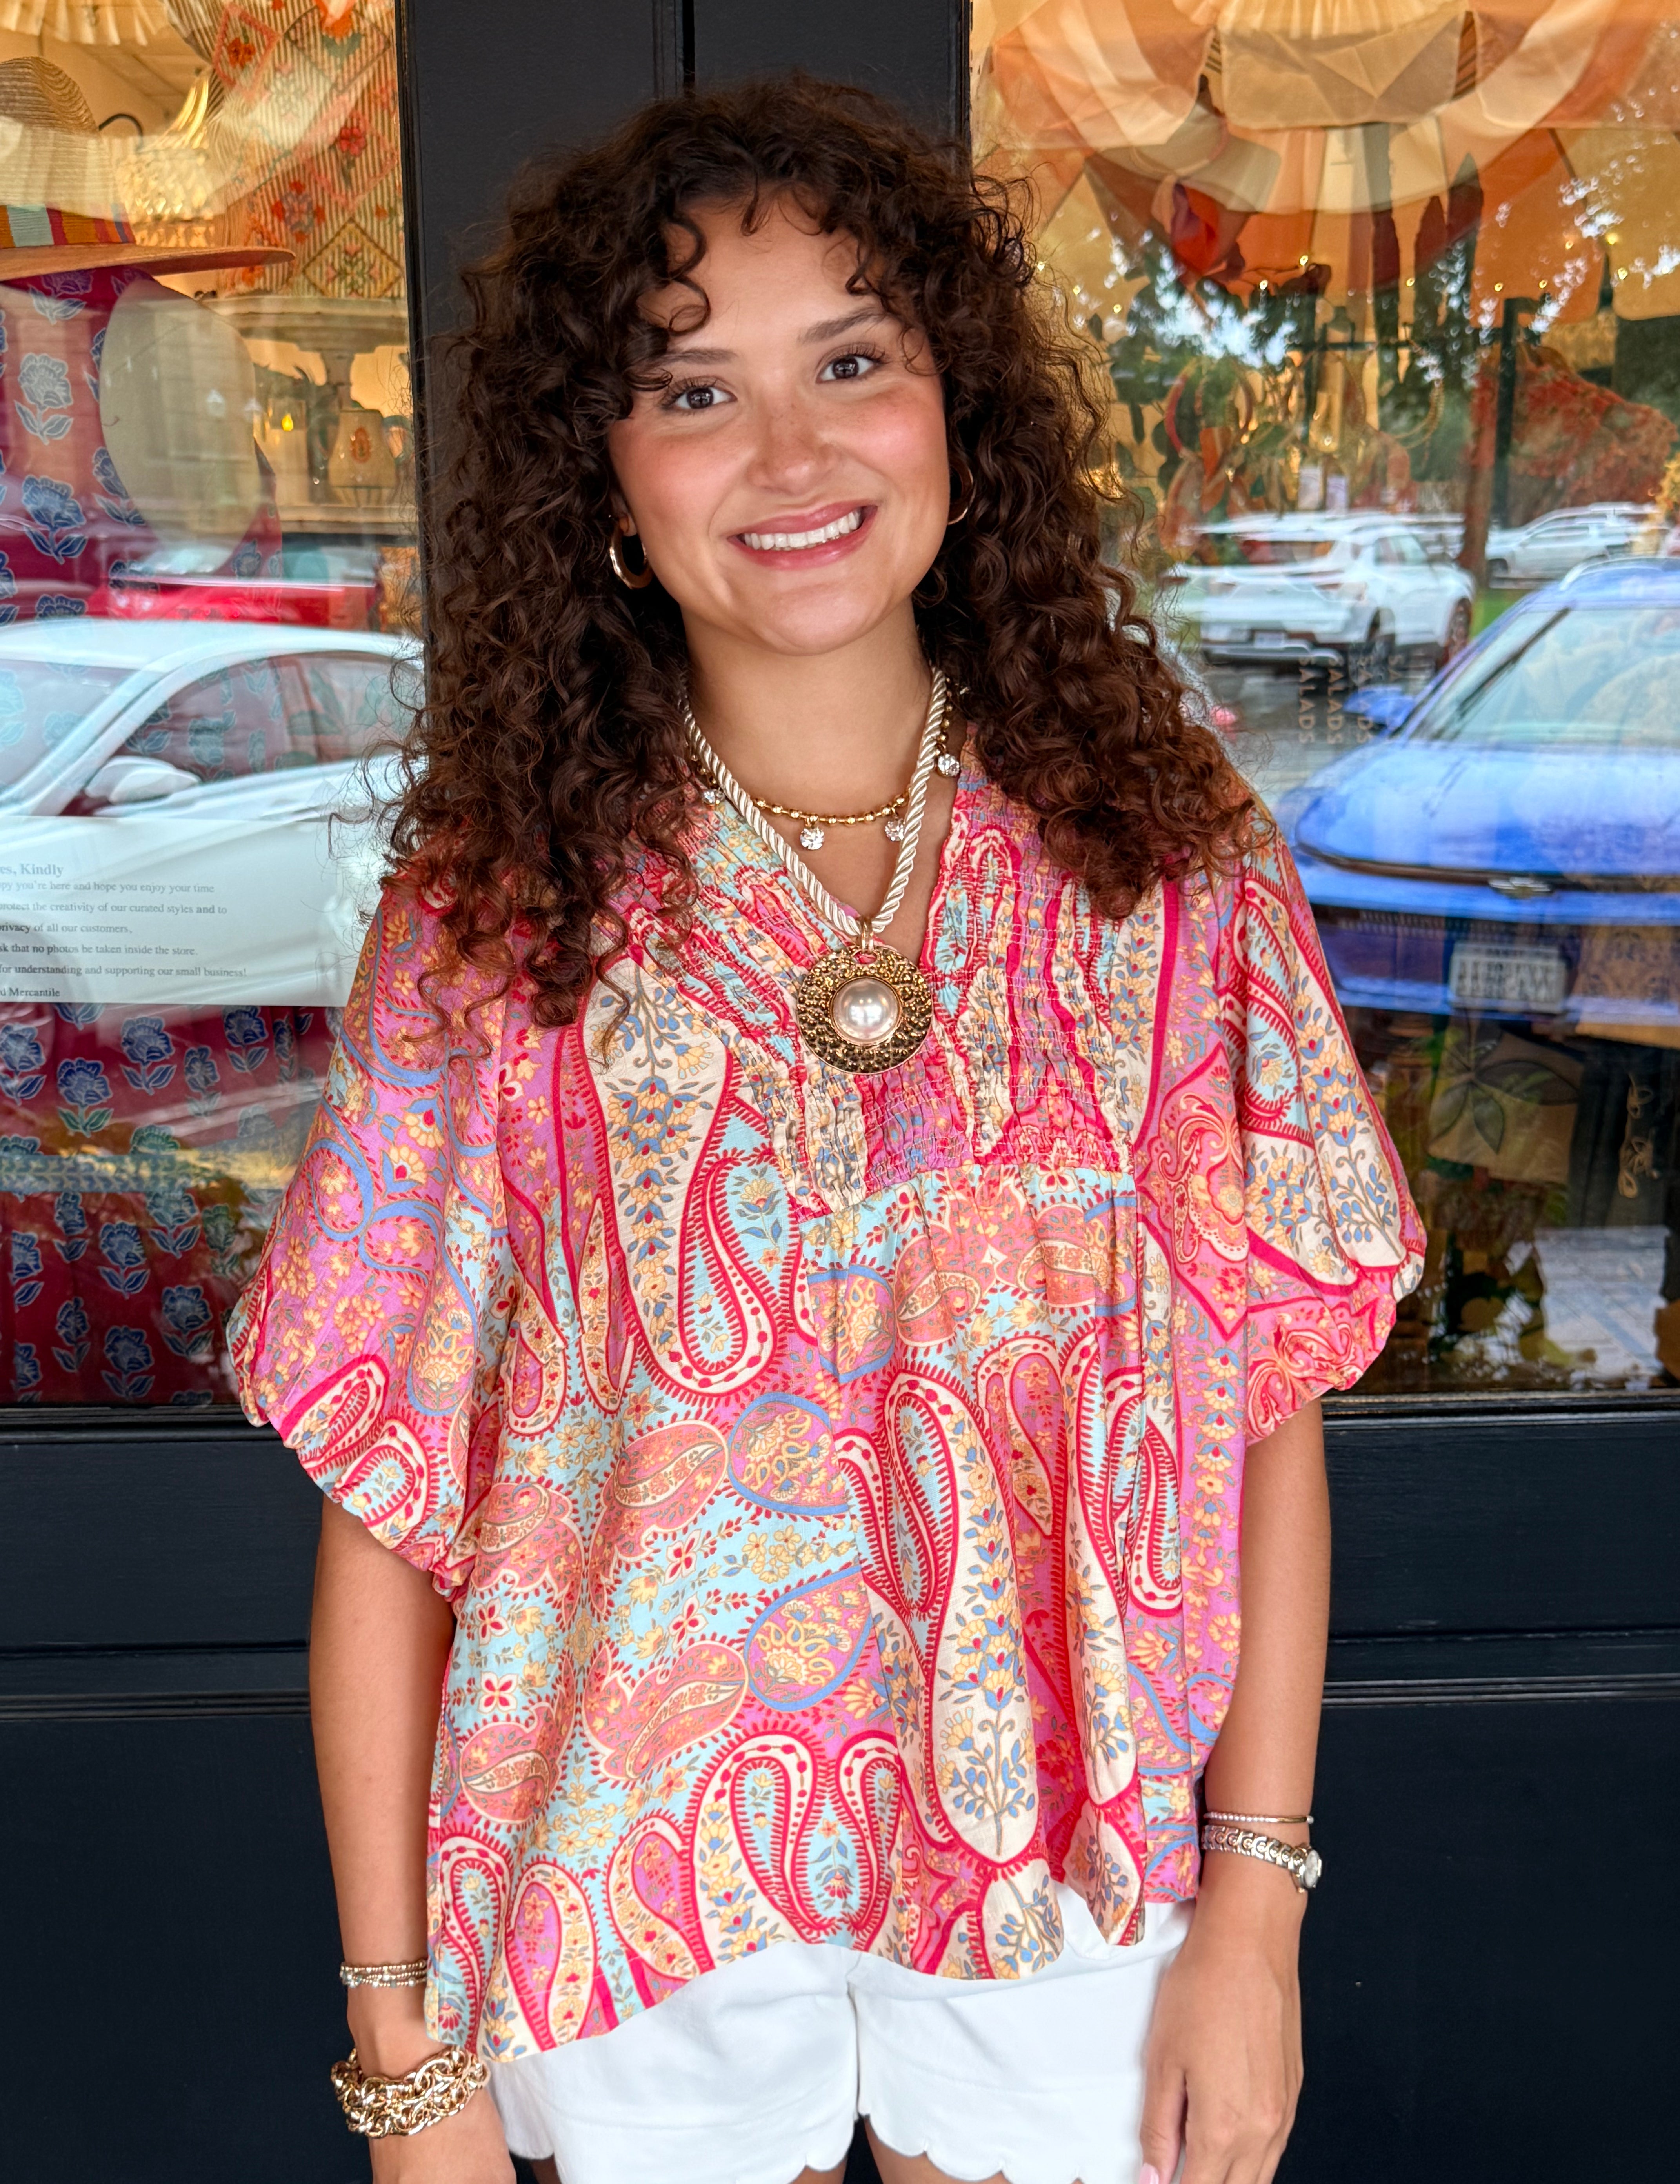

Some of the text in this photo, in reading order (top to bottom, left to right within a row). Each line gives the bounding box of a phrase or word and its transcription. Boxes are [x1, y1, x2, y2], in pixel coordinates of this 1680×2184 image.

[1298, 655, 1315, 744] SALADS
[1327, 655, 1344, 744] SALADS
[1357, 655, 1374, 744] SAADS
[20, 863, 64, 878] Kindly
[16, 881, 47, 892] you're
[50, 881, 71, 890] here
[73, 882, 91, 890] and
[94, 882, 116, 893] hope
[120, 884, 137, 893] you
[140, 884, 166, 894] enjoy
[169, 884, 191, 894] your
[193, 883, 215, 893] time
[33, 902, 47, 911] the
[50, 902, 95, 914] creativity
[98, 903, 109, 912] of
[129, 904, 164, 913] curated
[166, 904, 194, 915] styles
[196, 905, 215, 914] and
[34, 923, 44, 932] of
[47, 924, 59, 932] all
[80, 925, 133, 934] customers,
[11, 943, 30, 953] that
[47, 944, 79, 955] photos
[82, 944, 93, 953] be
[96, 944, 122, 954] taken
[124, 945, 153, 955] inside
[155, 945, 169, 955] the
[172, 946, 198, 956] store.
[15, 965, 82, 977] understanding
[85, 966, 102, 975] and
[105, 965, 155, 977] supporting
[175, 967, 201, 976] small
[204, 967, 247, 977] business!
[9, 987, 60, 997] Mercantile
